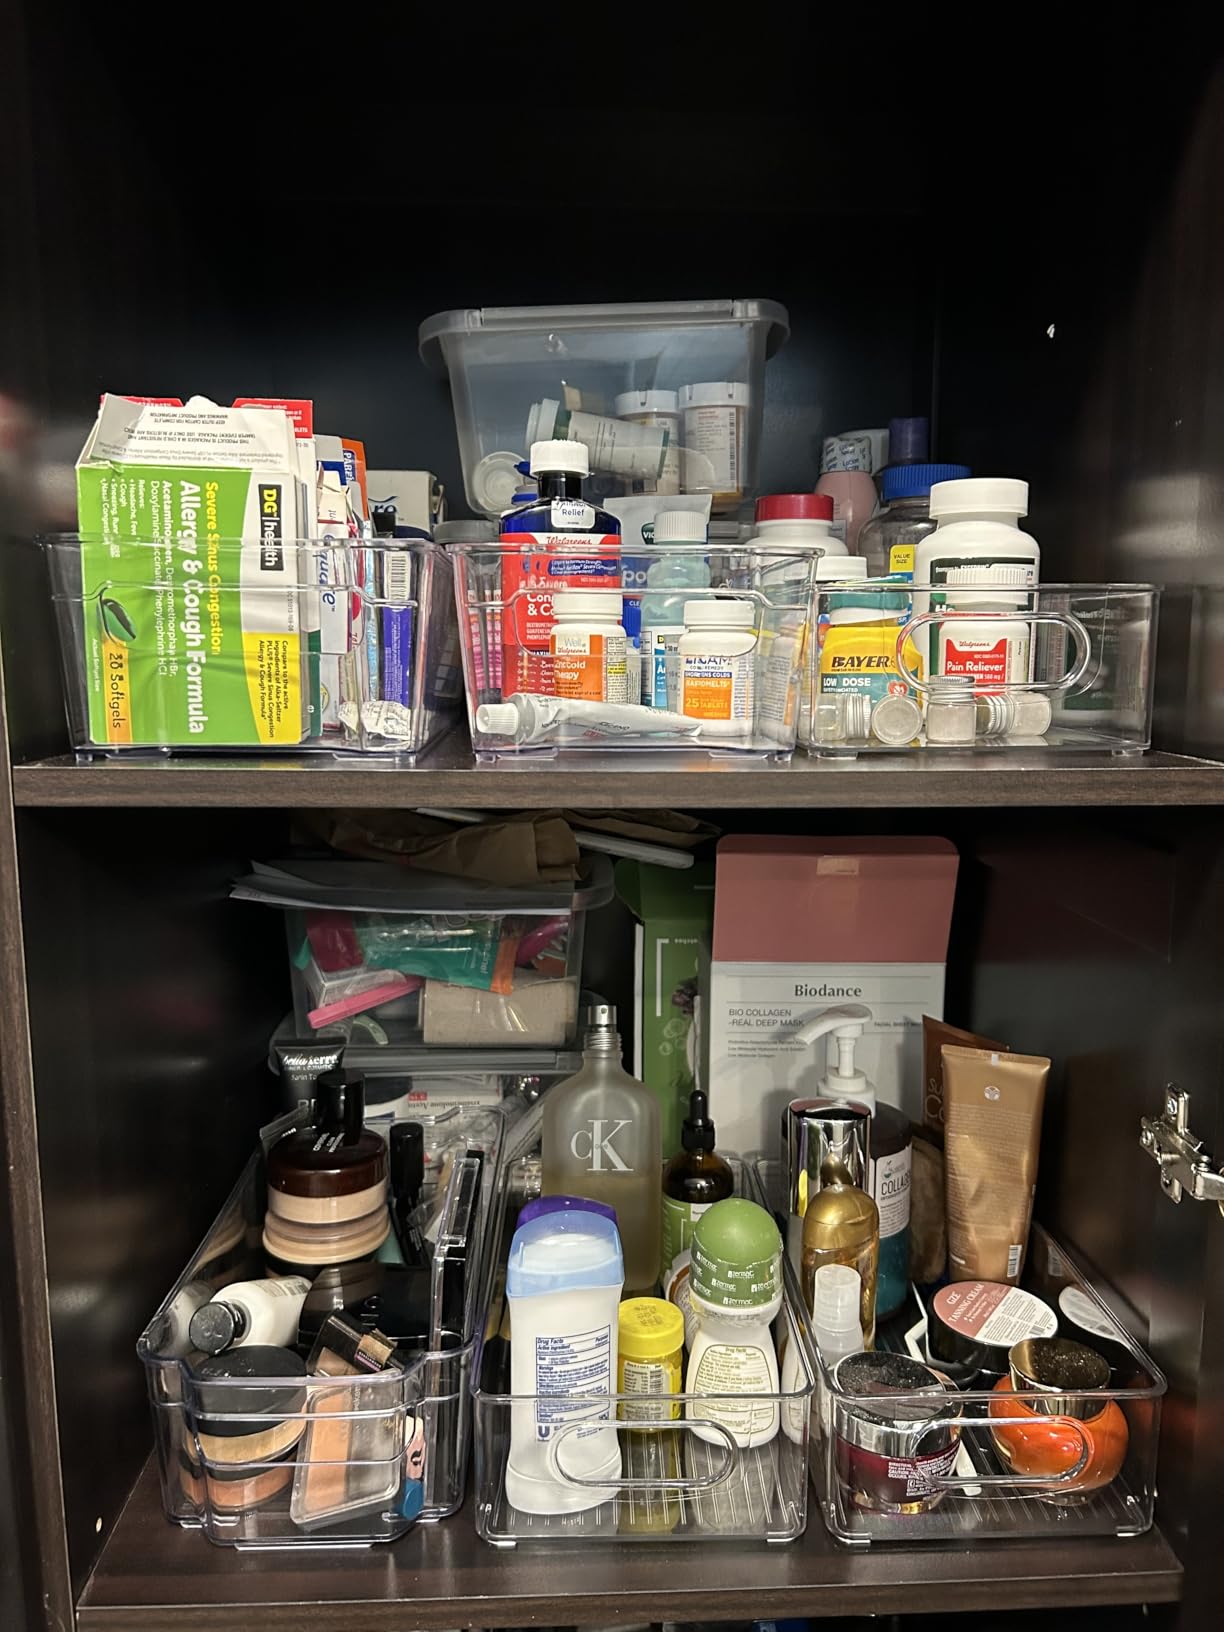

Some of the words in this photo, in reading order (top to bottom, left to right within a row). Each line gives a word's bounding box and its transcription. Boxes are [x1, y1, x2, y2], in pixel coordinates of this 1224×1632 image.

[205, 481, 220, 531] Severe
[263, 488, 278, 513] DG
[176, 480, 203, 556] Allergy
[561, 508, 585, 517] Relief
[162, 479, 175, 566] Acetaminoen,
[182, 558, 204, 576] &
[179, 578, 207, 648] Cough
[206, 572, 223, 656] Congestion
[527, 603, 538, 616] &
[831, 655, 889, 668] BAYER
[946, 660, 964, 672] Pain
[965, 660, 1004, 672] Reliever
[842, 677, 871, 687] DOSE
[185, 649, 209, 734] Formula
[109, 672, 128, 730] Softgels
[794, 984, 862, 998] Biodance
[728, 1008, 744, 1017] BIO
[746, 1008, 792, 1017] COLLAGEN
[755, 1019, 778, 1027] DEEP
[780, 1019, 805, 1027] MASK
